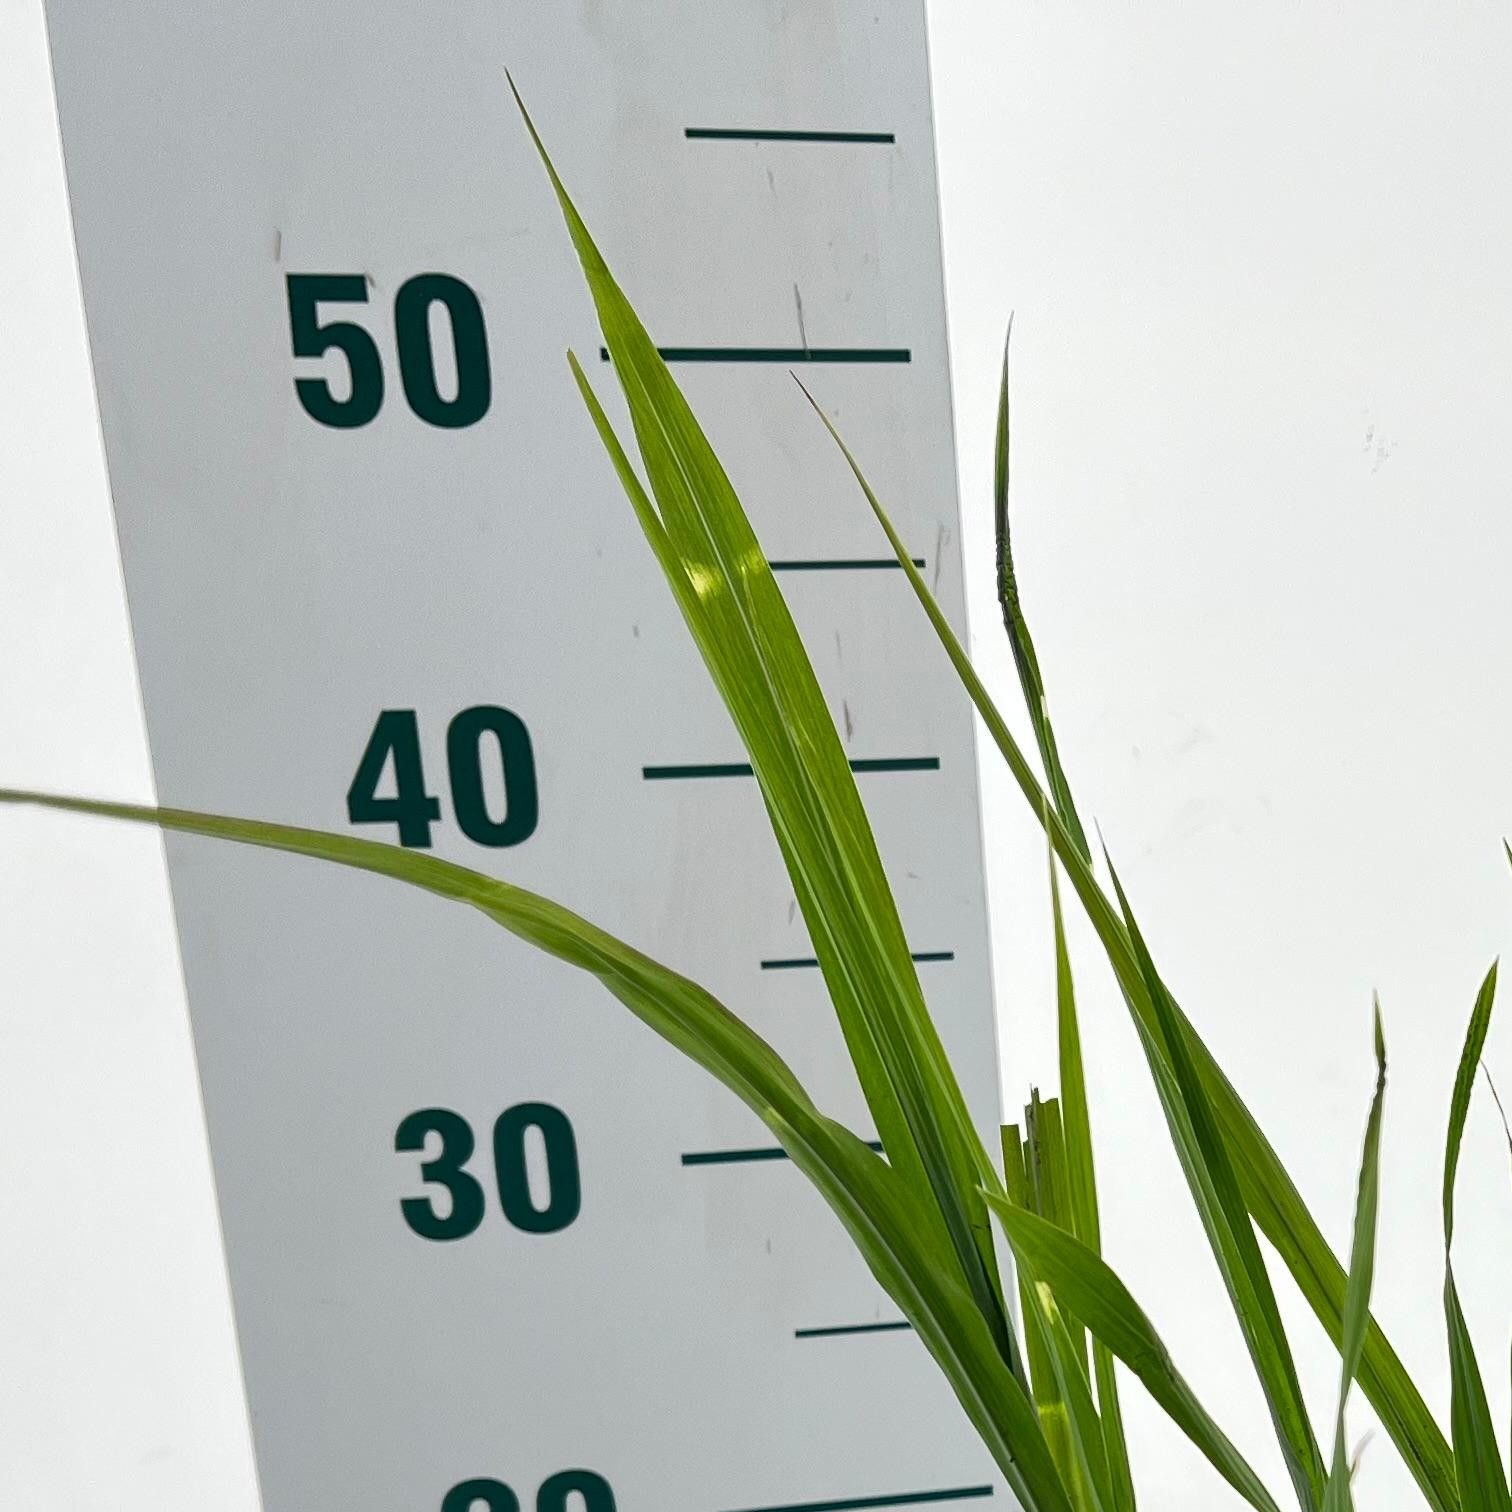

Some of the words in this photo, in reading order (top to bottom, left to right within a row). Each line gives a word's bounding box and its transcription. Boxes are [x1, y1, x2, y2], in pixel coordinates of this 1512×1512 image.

[285, 272, 492, 430] 50
[346, 704, 539, 849] 40
[394, 1101, 582, 1242] 30
